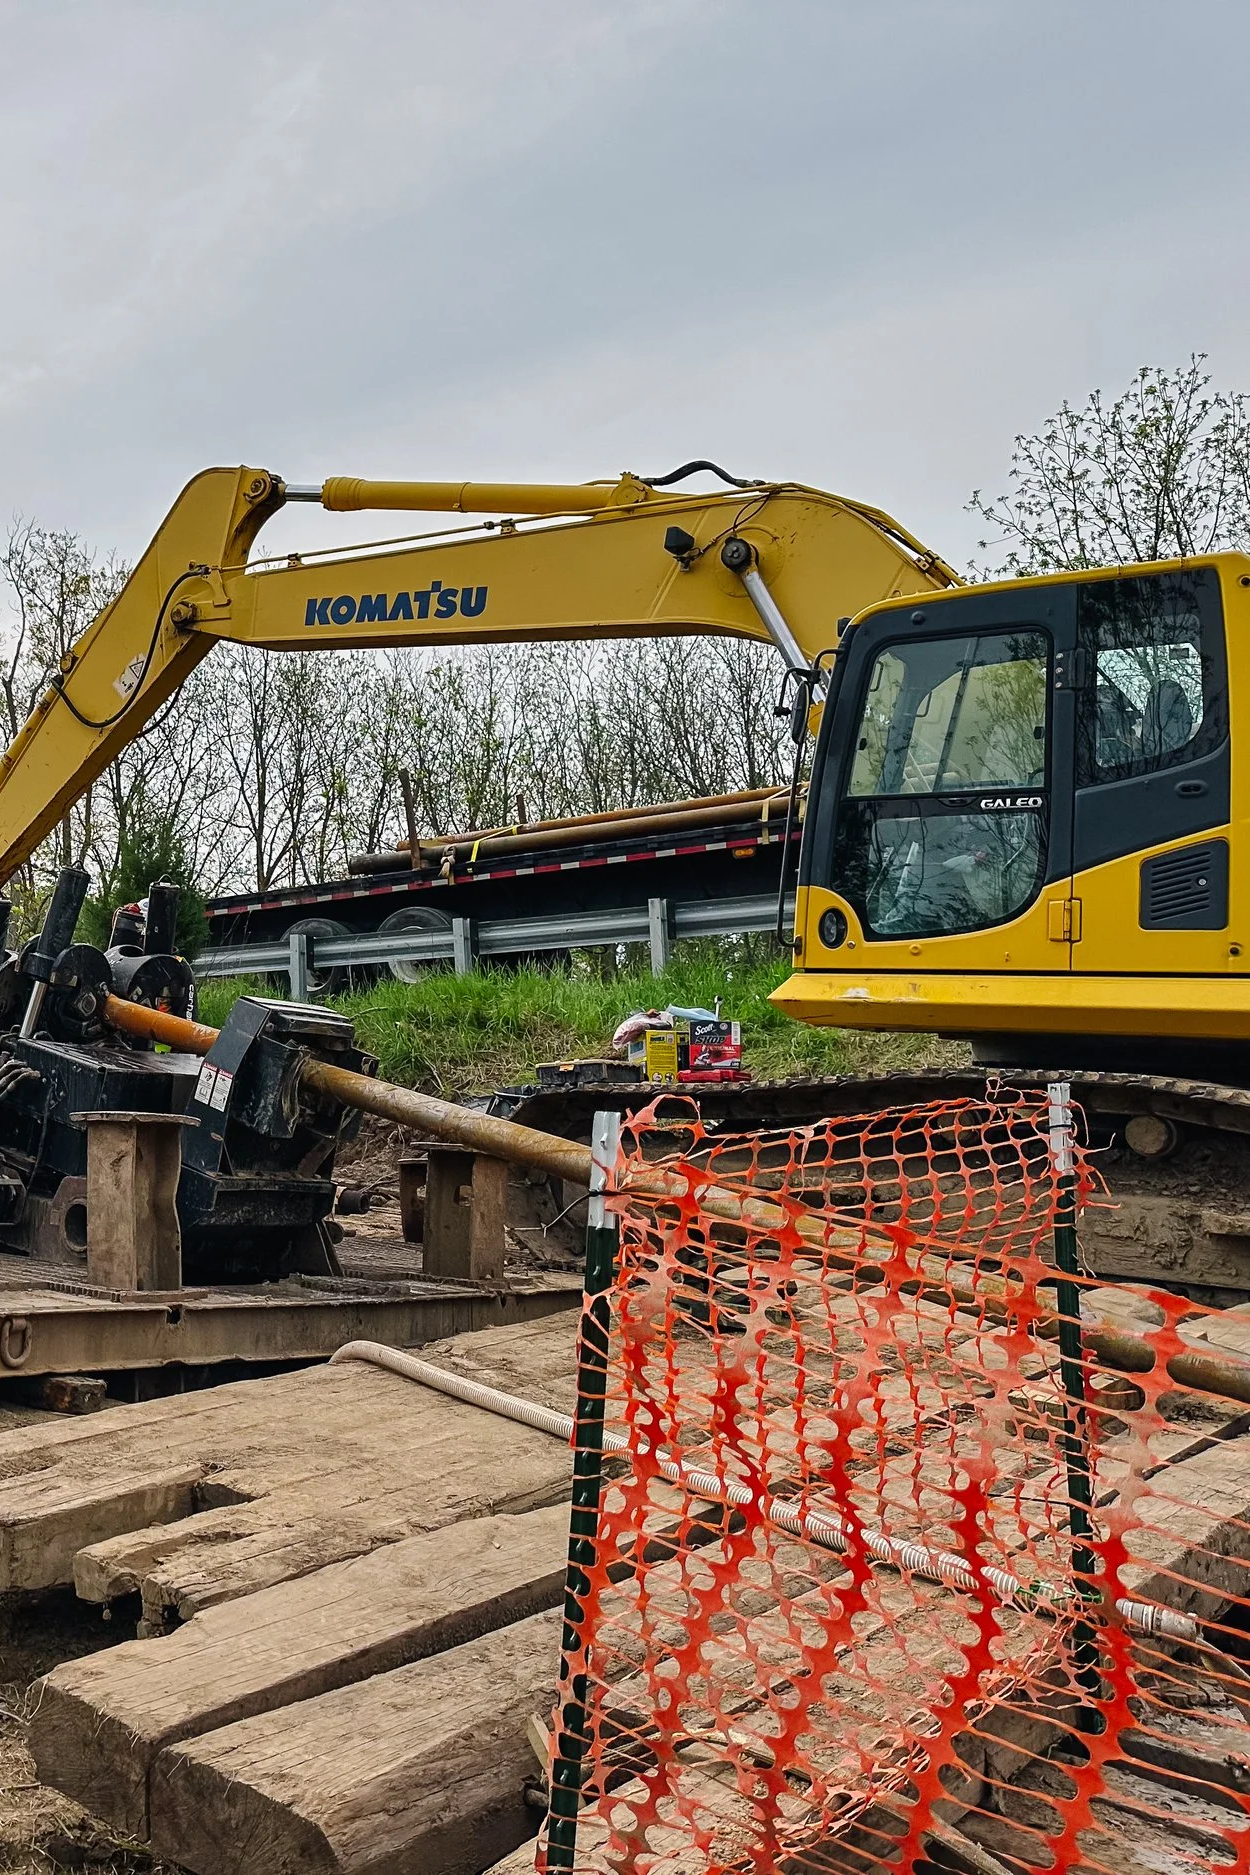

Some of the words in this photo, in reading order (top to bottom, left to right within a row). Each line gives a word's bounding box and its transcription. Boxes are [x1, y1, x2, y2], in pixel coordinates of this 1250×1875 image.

[304, 581, 488, 626] KOMATSU
[980, 797, 1043, 810] GALEO
[695, 1035, 727, 1045] SHOP
